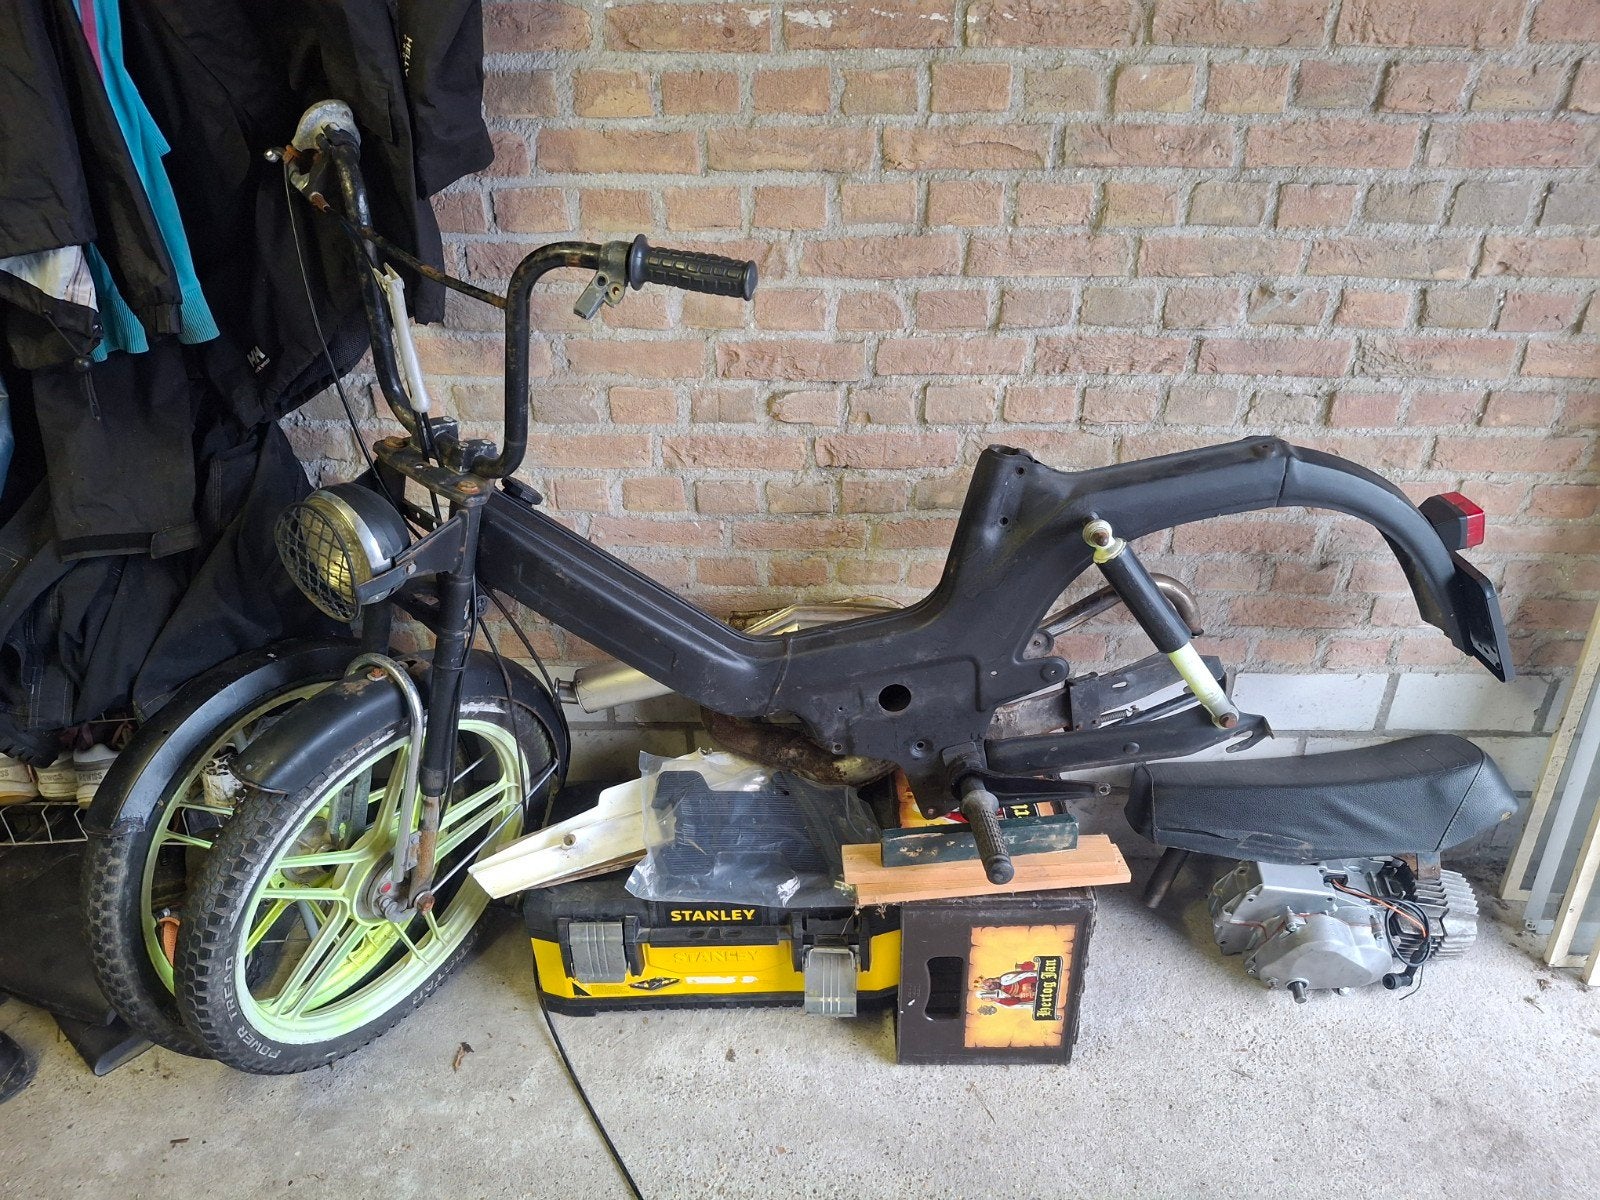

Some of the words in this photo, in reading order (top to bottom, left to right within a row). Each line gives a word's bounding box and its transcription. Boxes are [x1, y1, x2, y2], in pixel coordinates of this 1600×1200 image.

[404, 36, 413, 77] HELLY
[670, 909, 755, 922] STANLEY
[673, 951, 758, 963] STANLEY
[1041, 959, 1057, 980] Jan
[223, 956, 238, 1022] TREAD
[1037, 981, 1057, 1017] Hertog
[236, 1025, 282, 1059] POWER
